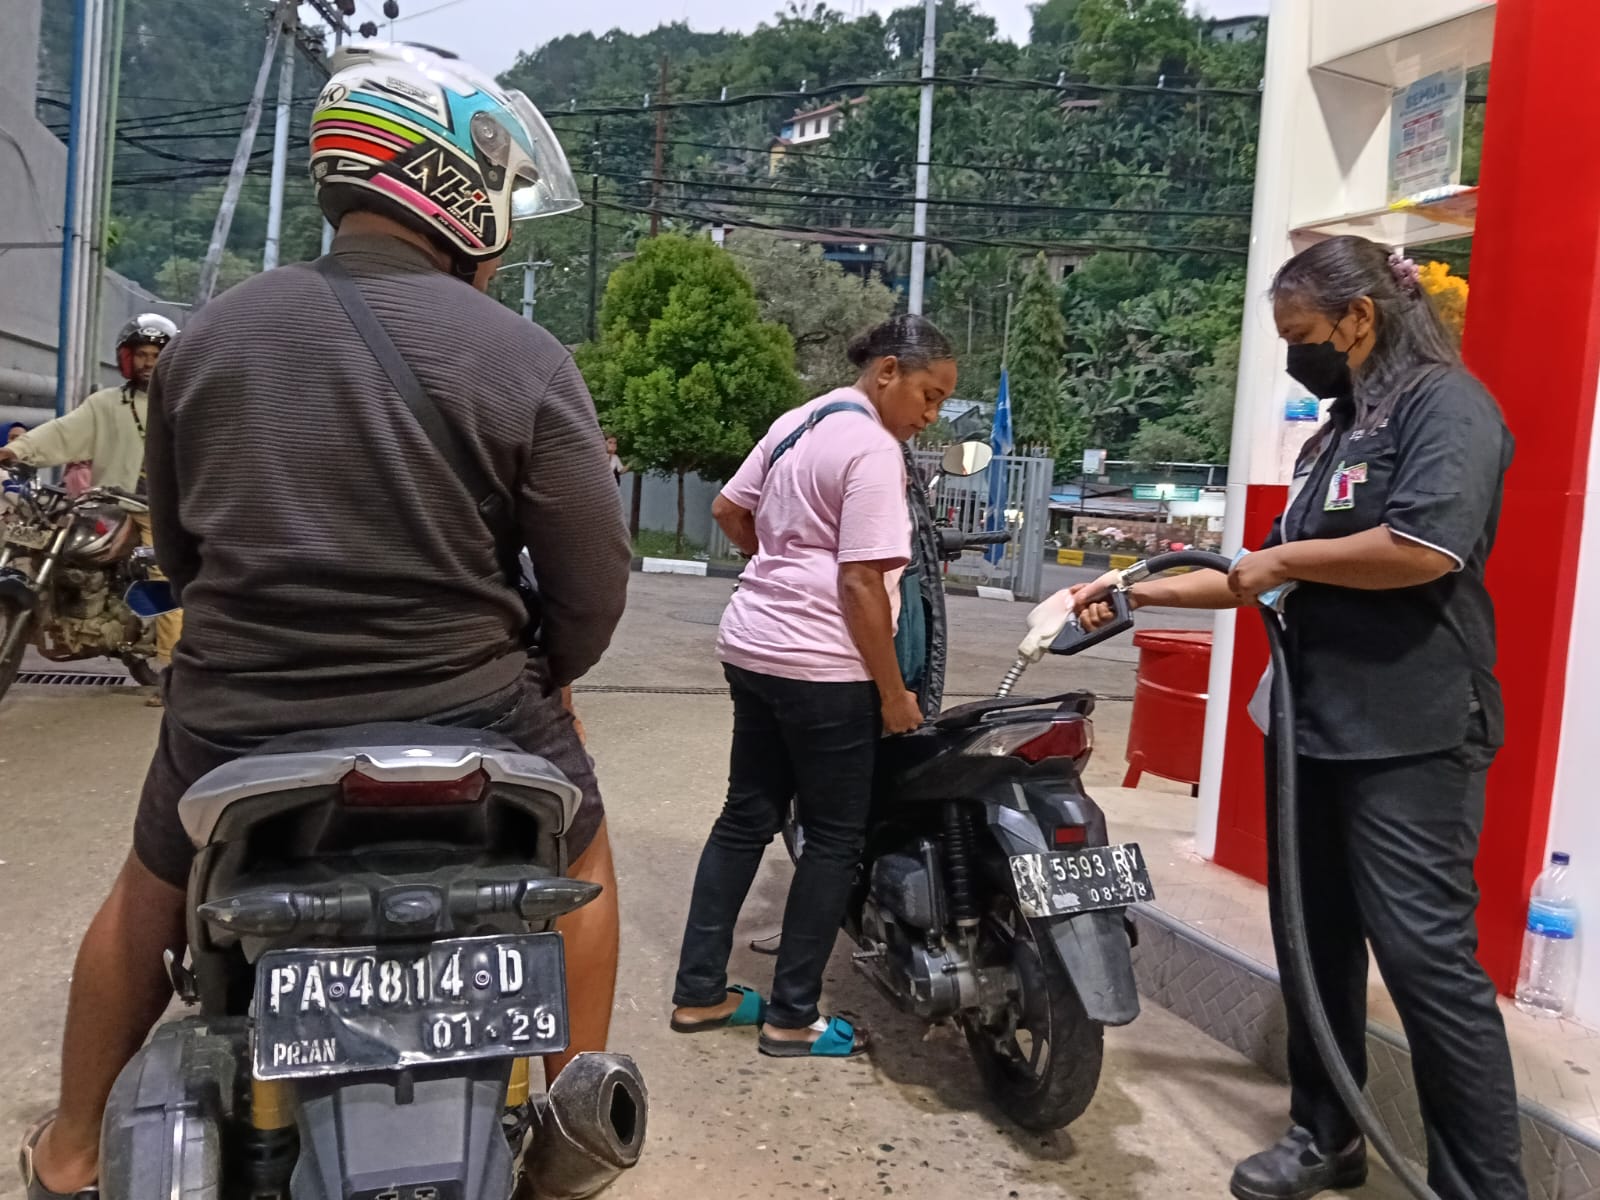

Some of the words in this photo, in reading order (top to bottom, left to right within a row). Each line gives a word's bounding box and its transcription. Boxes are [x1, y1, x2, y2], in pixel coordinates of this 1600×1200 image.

[402, 147, 496, 237] NHK
[1050, 853, 1106, 881] 5593
[1111, 847, 1138, 874] RY
[270, 965, 326, 1014] PA
[349, 947, 465, 1006] 4814
[497, 947, 523, 993] D
